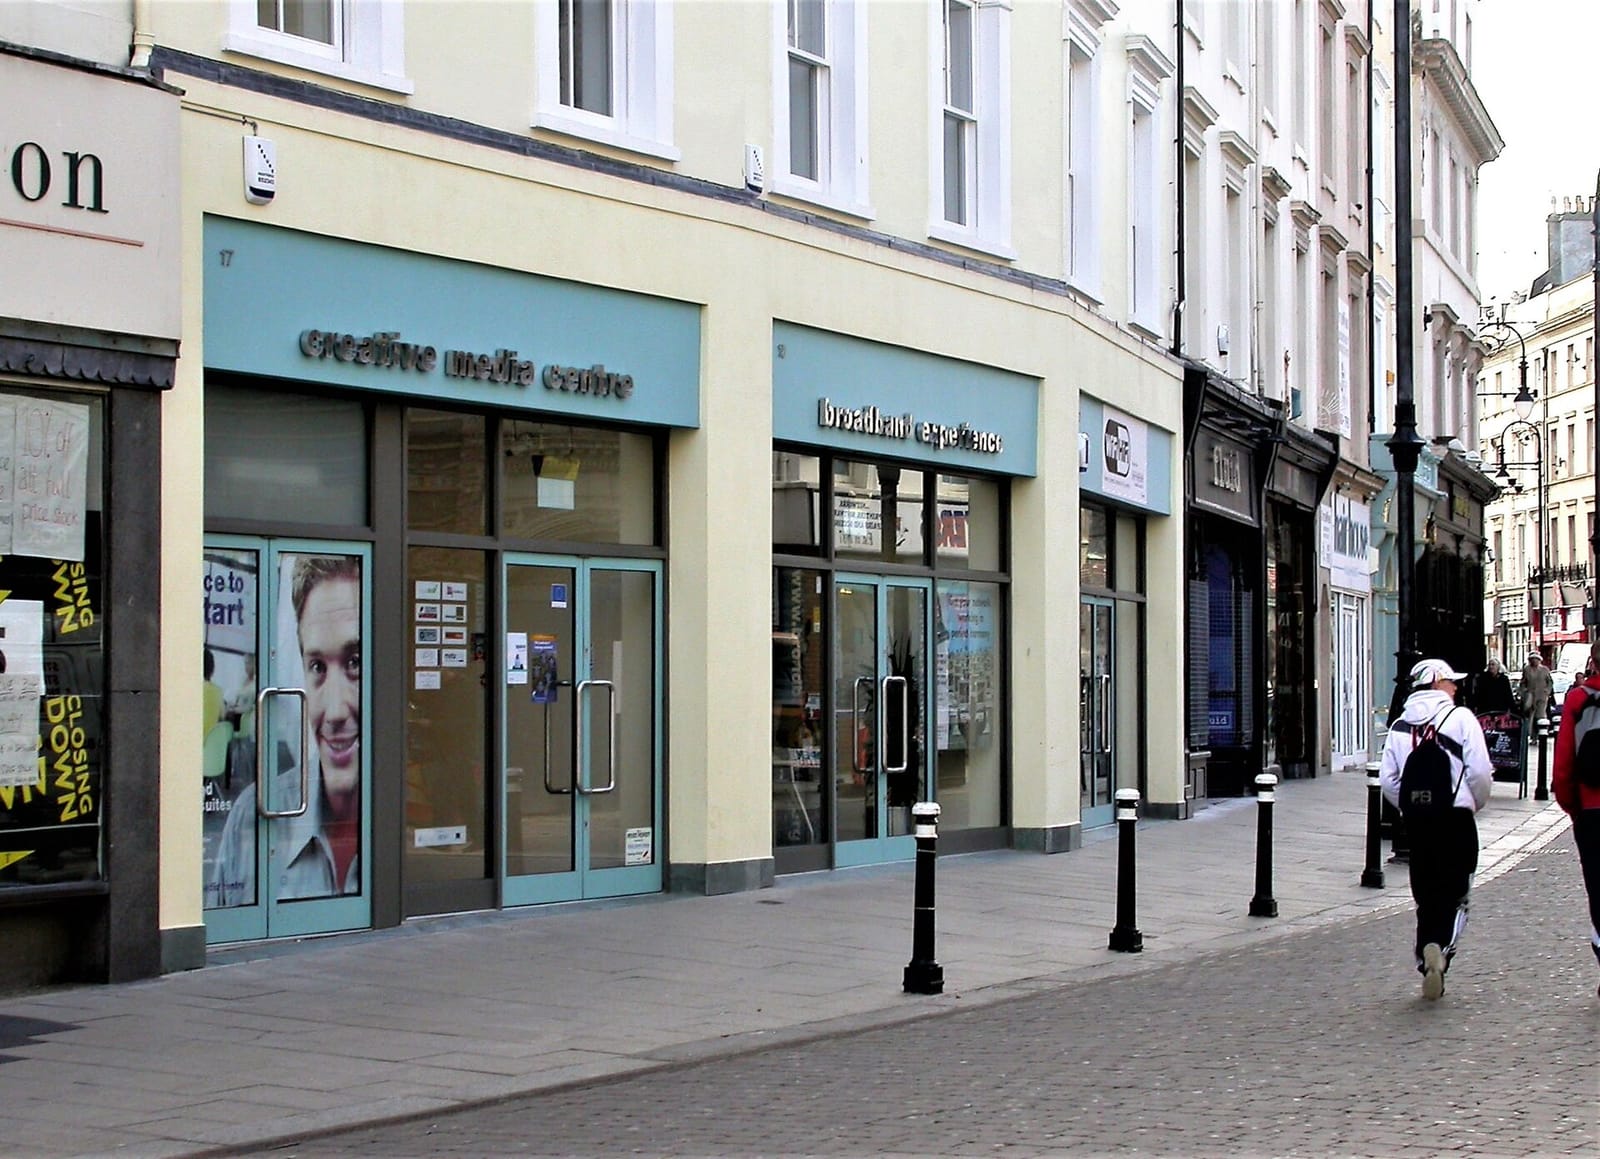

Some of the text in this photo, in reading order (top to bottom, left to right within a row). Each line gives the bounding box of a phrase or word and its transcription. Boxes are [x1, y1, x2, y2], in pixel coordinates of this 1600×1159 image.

[219, 249, 234, 267] 17
[299, 328, 635, 399] creative media centre
[818, 397, 1004, 454] broadband experience
[228, 570, 244, 593] to
[46, 697, 79, 823] DOWN
[67, 695, 93, 816] CLOSING
